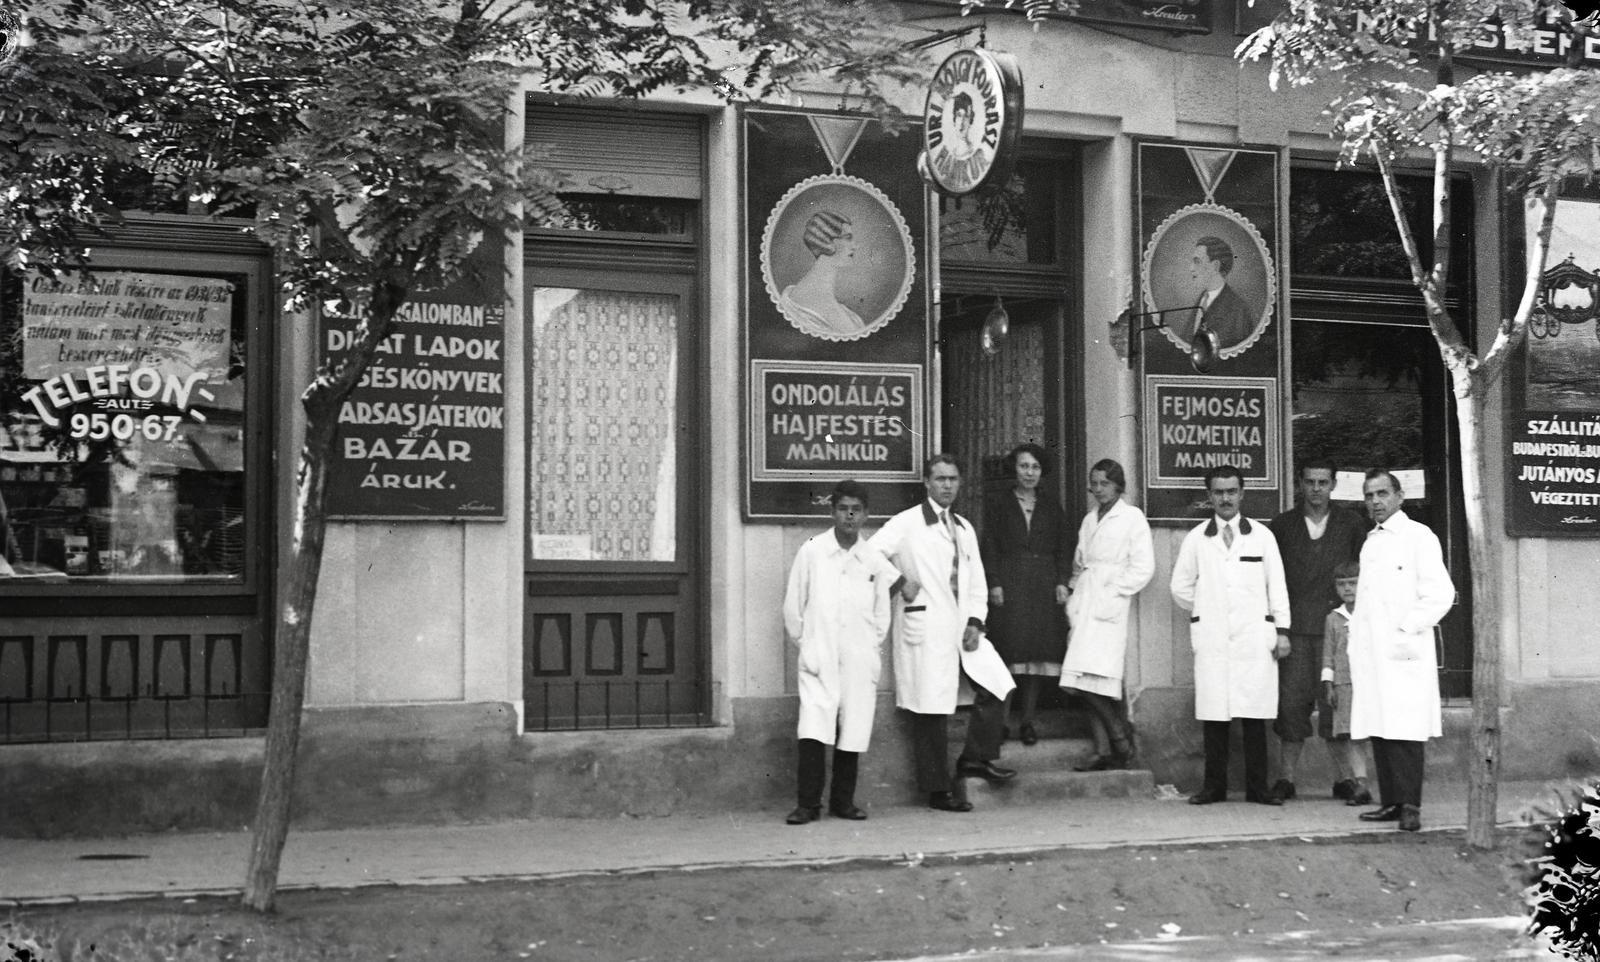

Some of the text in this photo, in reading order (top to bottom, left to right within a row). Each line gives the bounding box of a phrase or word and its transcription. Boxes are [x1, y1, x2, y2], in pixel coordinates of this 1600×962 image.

[927, 103, 944, 150] URI
[327, 329, 501, 360] DIAT LAPOK
[21, 364, 208, 427] TELEFON
[771, 376, 905, 407] ONDOLÁLÁS
[1162, 390, 1261, 420] FEJMOSÁS
[772, 407, 903, 441] HAJFESTÉS
[1162, 424, 1262, 446] KOZMETIKA
[344, 428, 472, 462] BAZÁR
[786, 438, 888, 461] MANIKÜR
[1175, 448, 1252, 469] MANIKÜR
[1518, 459, 1596, 484] JUTÁNYOS
